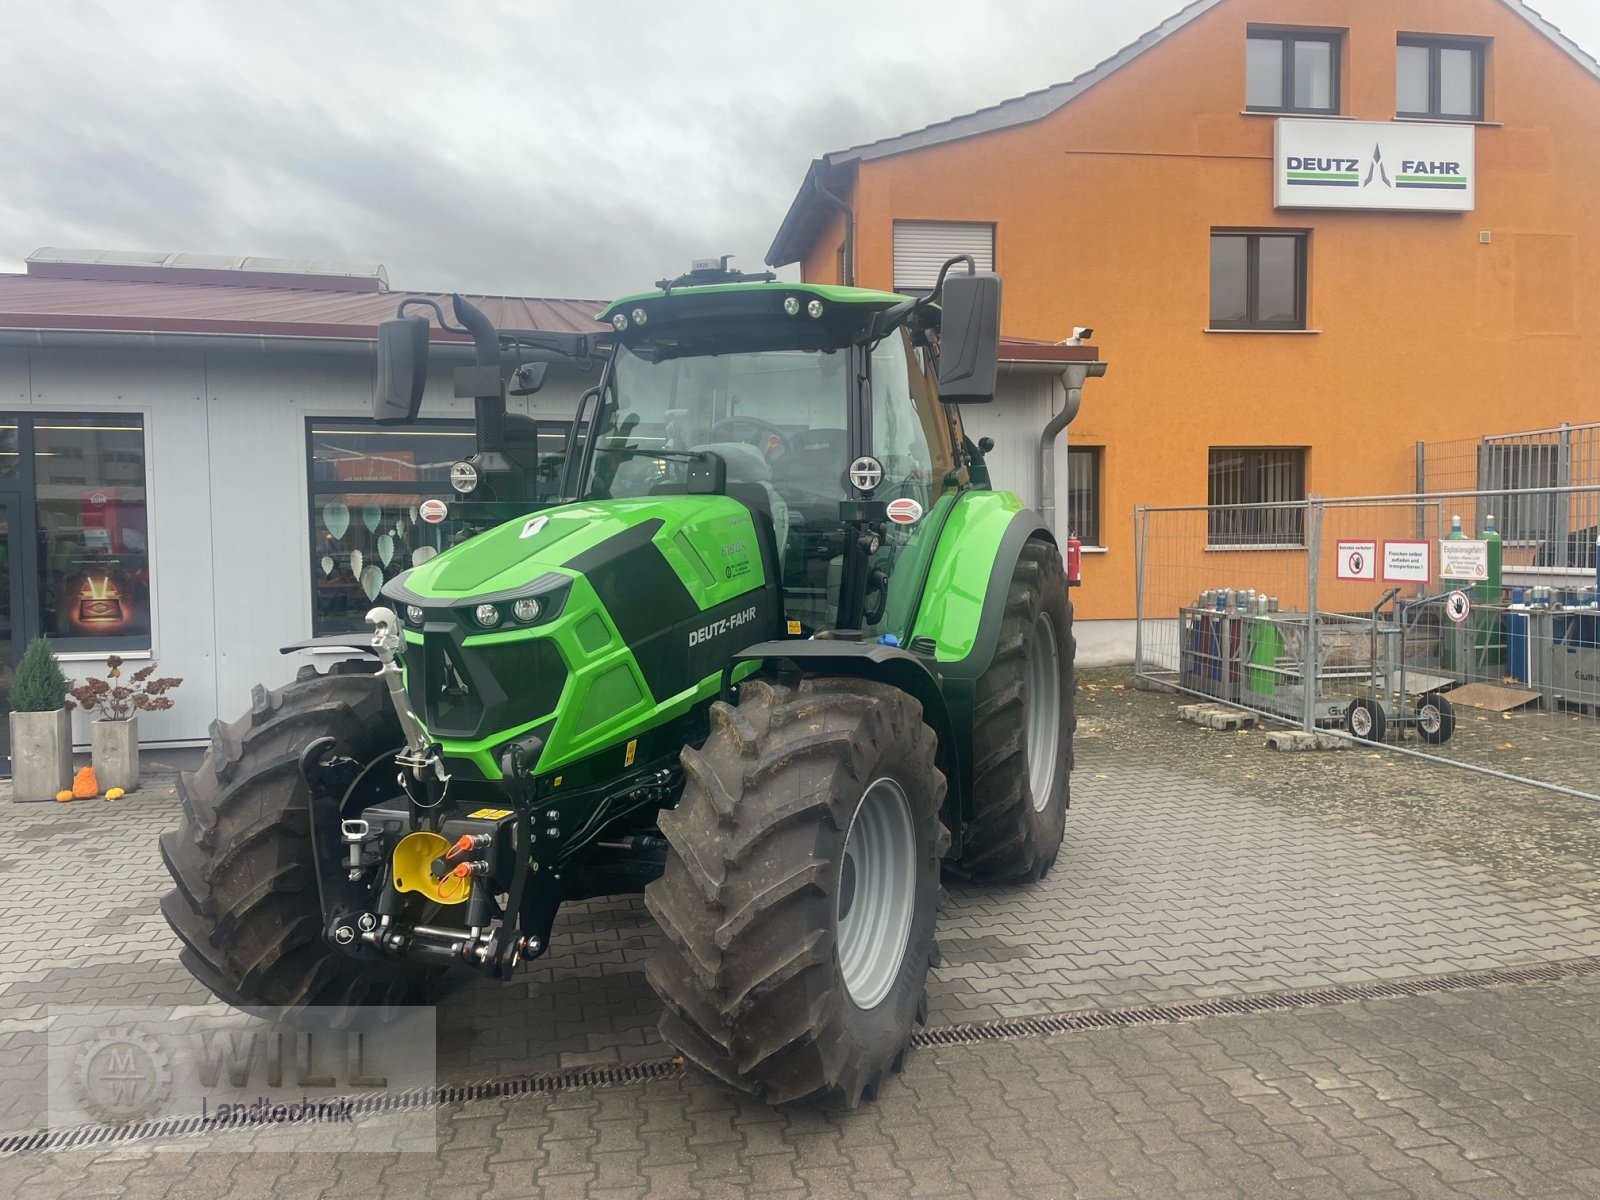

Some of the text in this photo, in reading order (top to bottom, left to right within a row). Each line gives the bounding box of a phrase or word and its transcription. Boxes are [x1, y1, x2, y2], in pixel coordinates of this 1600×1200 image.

[1287, 157, 1460, 175] DEUTZ FAHR
[689, 606, 756, 648] DEUTZ-FAHR
